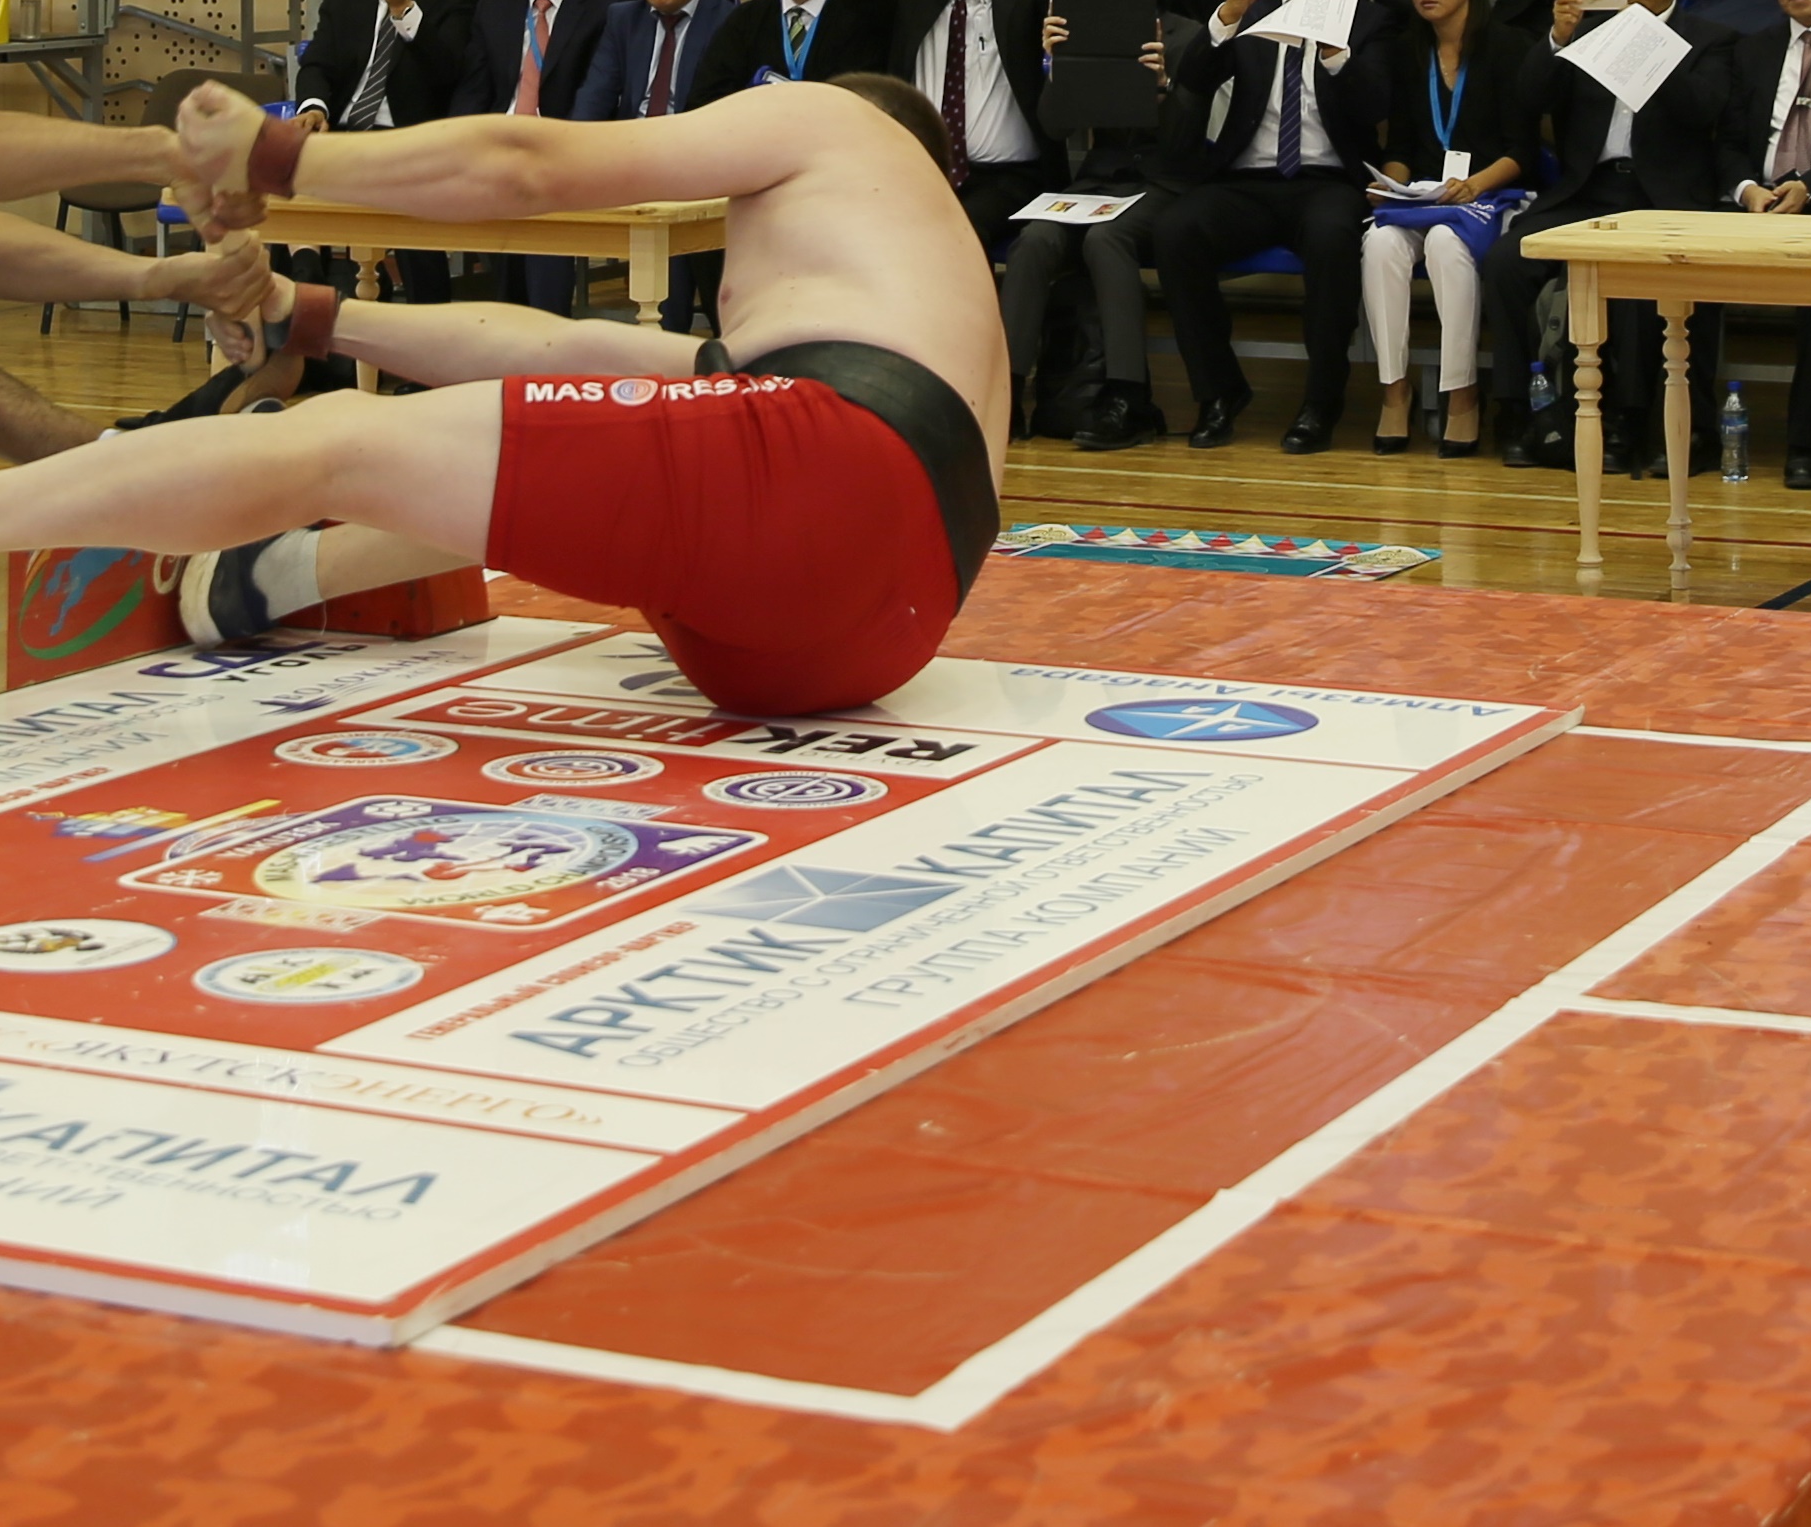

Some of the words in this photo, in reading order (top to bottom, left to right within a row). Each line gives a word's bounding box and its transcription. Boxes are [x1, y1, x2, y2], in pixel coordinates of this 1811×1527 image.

[525, 381, 606, 403] MAS
[213, 643, 369, 683] УГОЛЬ
[273, 648, 458, 702] ВОДОКАНАЛ
[1009, 667, 1251, 694] Анабара
[445, 700, 732, 742] time
[1269, 689, 1509, 716] Алмазы
[728, 722, 977, 764] REK
[399, 884, 538, 904] WORLD
[514, 929, 842, 1056] АРКТИК
[899, 771, 1205, 878] КАПИТАЛ
[617, 989, 802, 1066] ОБЩЕСТВО
[788, 976, 831, 987] С
[816, 880, 1027, 974] ОГРАНИЧЕННОЙ
[1021, 774, 1262, 879] ОТВЕТСТВЕННОСТЬЮ
[843, 930, 1041, 1006] ГРУППА
[1014, 827, 1245, 924] КОМПАНИЙ
[409, 985, 548, 1039] ГЕНЕРАЛЬНЫЙ
[24, 1035, 603, 1129] «ЯКУТСКЭНЕРГО»
